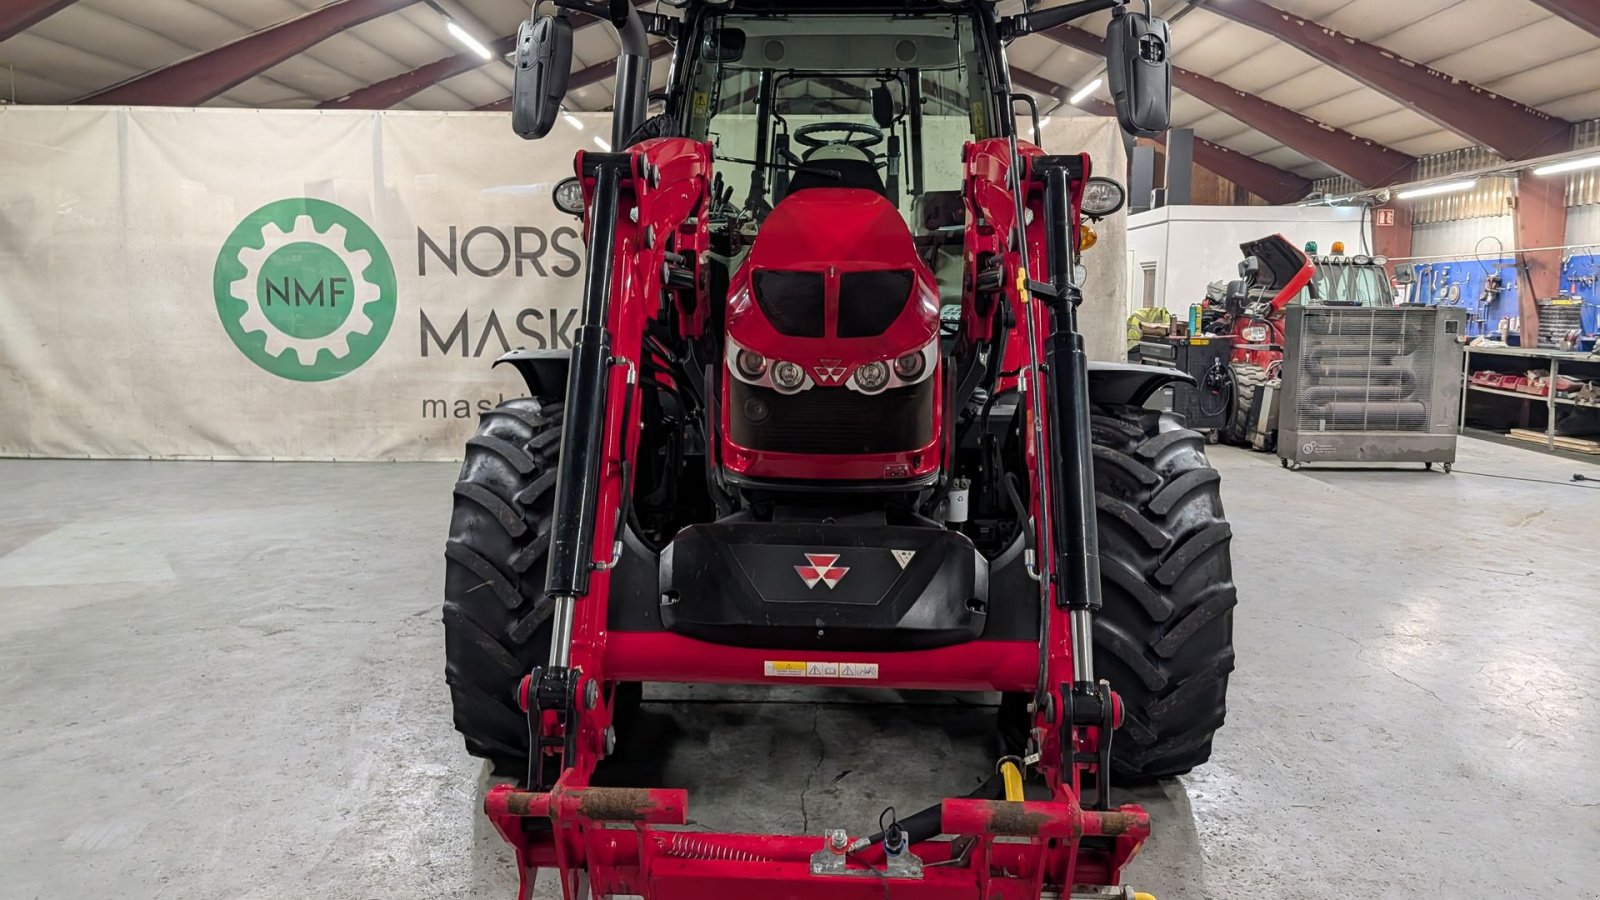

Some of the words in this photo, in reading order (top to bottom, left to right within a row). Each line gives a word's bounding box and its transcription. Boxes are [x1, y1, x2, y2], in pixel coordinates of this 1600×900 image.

[417, 225, 581, 278] NORS
[265, 276, 347, 307] NMF
[420, 307, 579, 358] MASK
